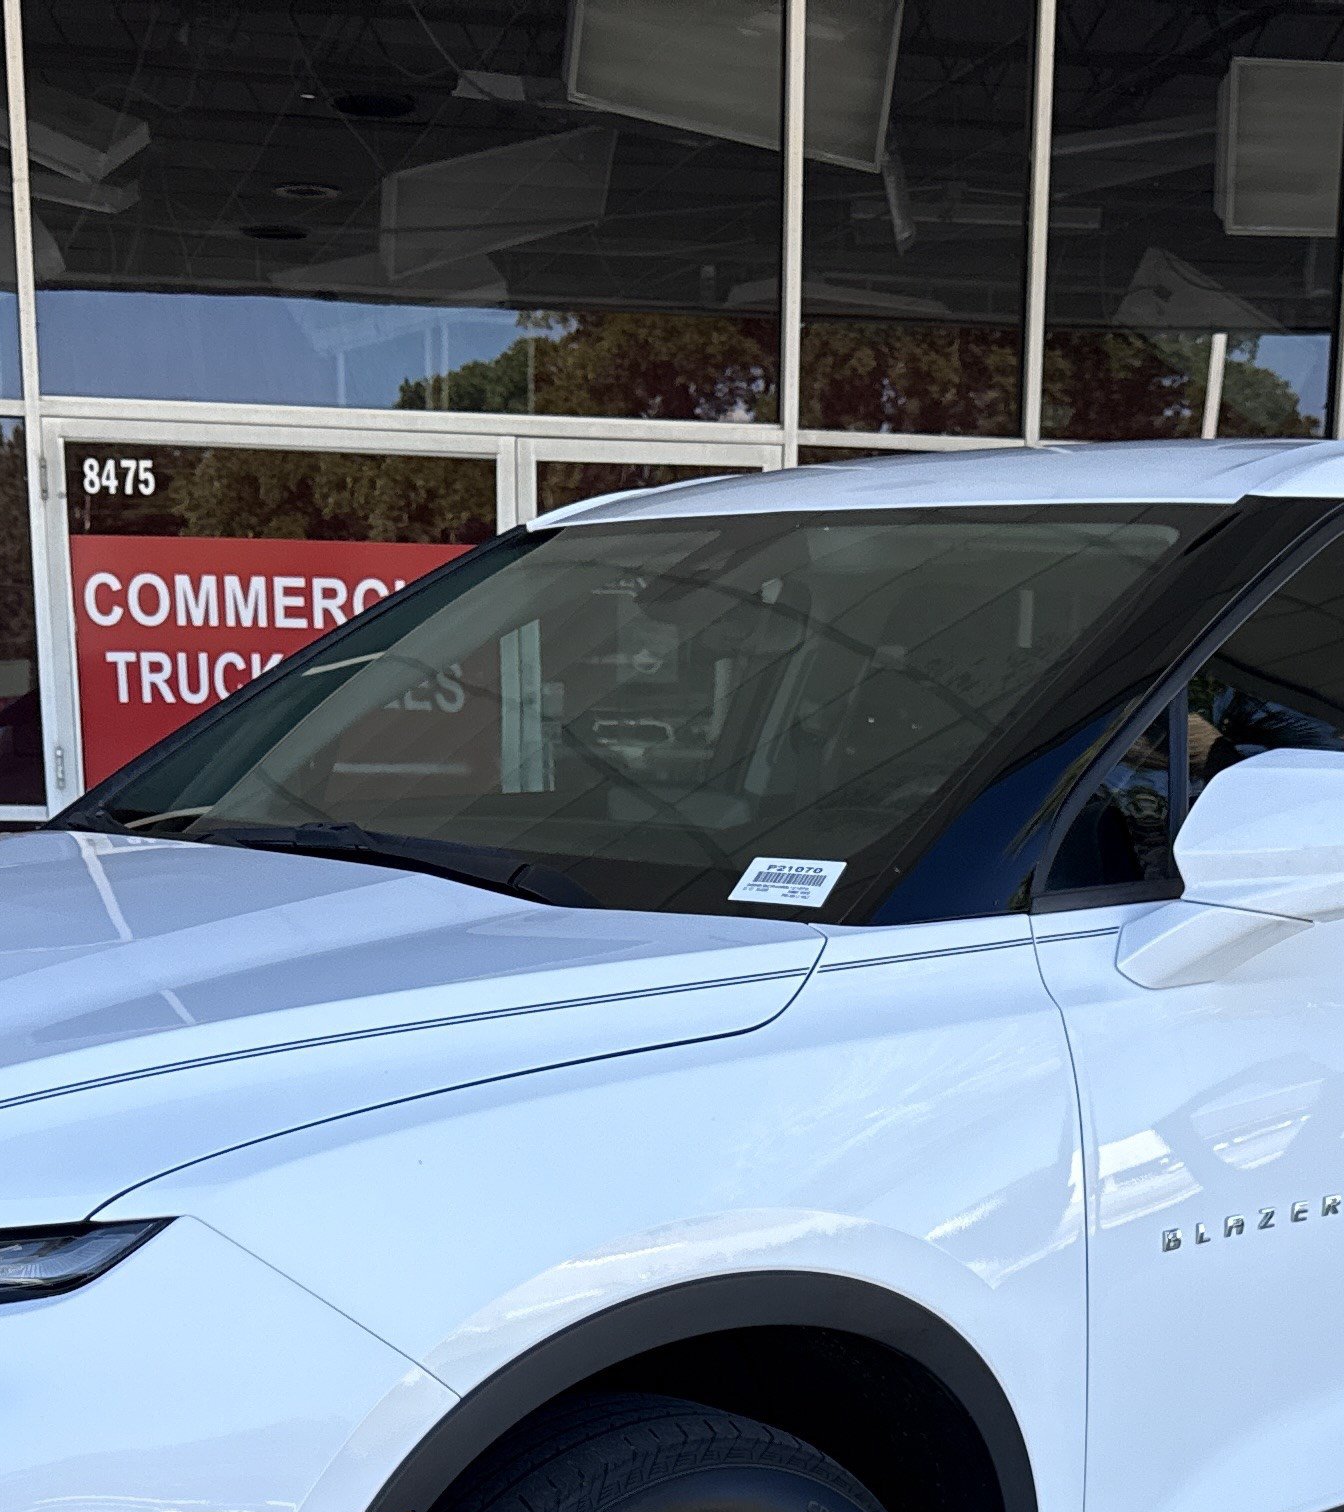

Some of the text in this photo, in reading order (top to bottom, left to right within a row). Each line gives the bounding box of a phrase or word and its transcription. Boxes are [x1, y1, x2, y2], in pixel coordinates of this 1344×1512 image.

[83, 457, 156, 496] 8475
[83, 571, 407, 630] COMMERC
[105, 651, 284, 705] TRUCK
[767, 864, 823, 874] P21070
[1162, 1193, 1342, 1252] BLAZER
